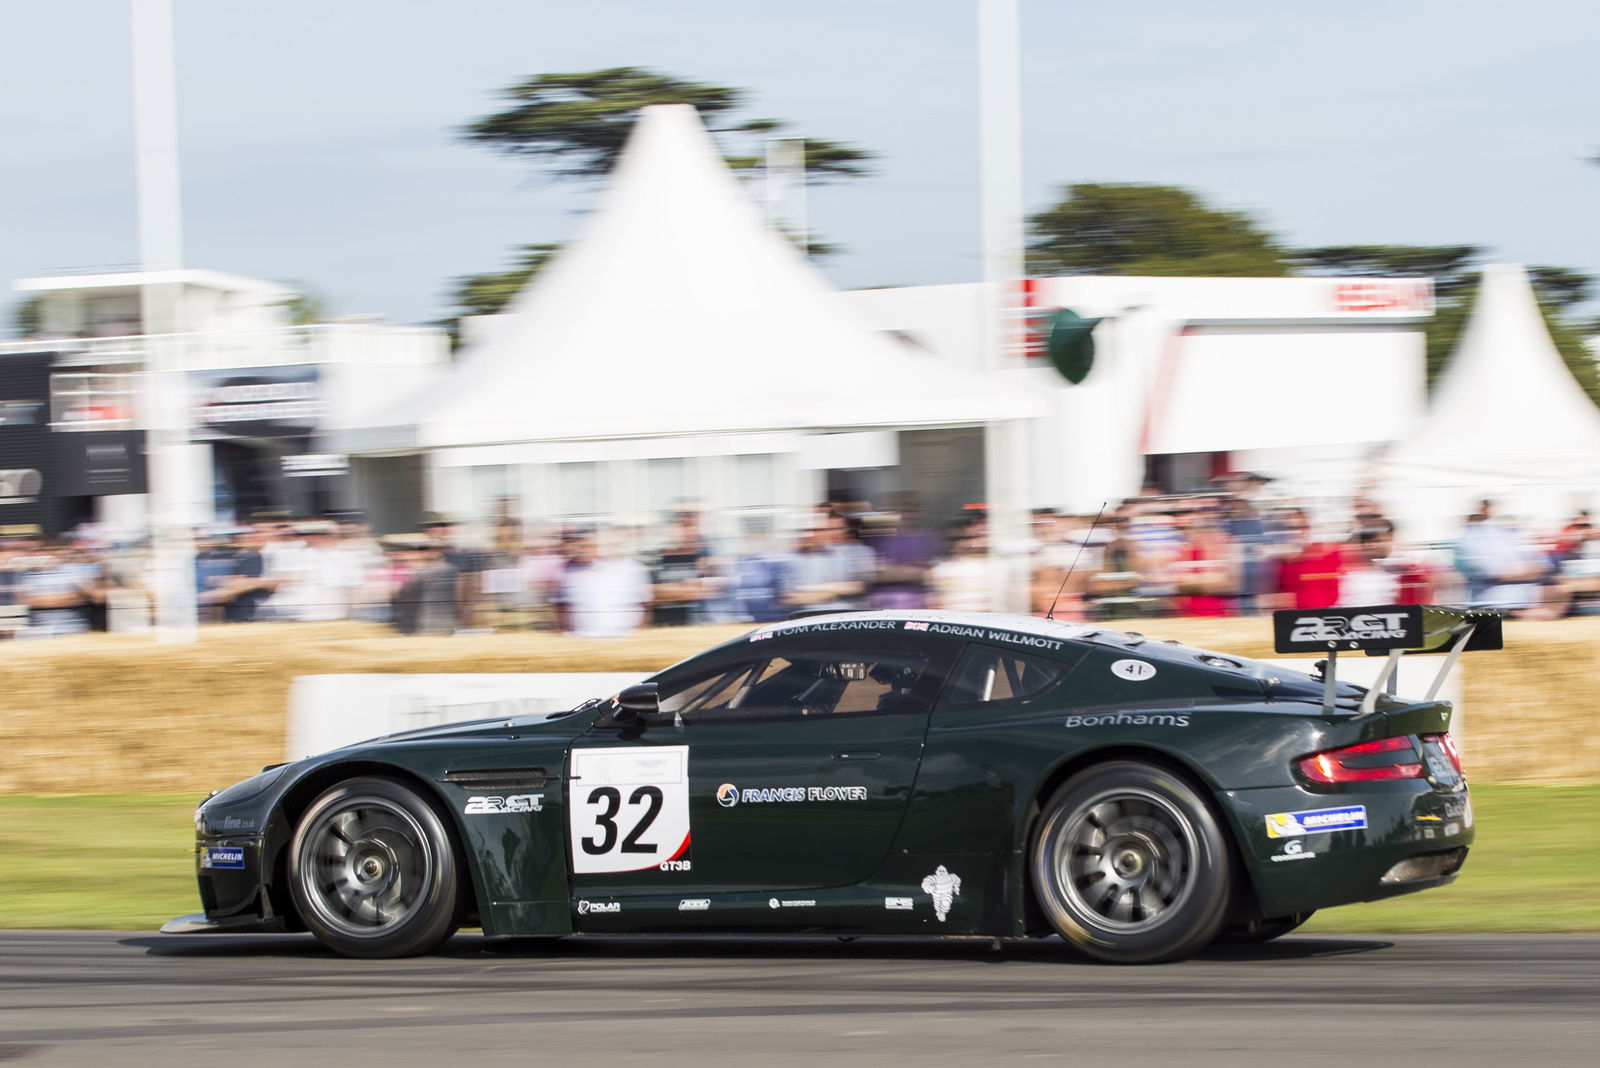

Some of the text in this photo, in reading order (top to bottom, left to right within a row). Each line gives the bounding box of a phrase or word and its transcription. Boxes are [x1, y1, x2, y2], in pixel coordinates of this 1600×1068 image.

[776, 620, 896, 637] TOM ALEXANDER
[928, 623, 1064, 651] ADRIAN WILLMOTT
[1125, 664, 1143, 675] 41
[1065, 713, 1191, 728] Bonhams
[741, 786, 868, 803] FRANCIS FLOWER
[581, 785, 664, 855] 32
[212, 852, 243, 861] MICHELIN
[660, 860, 691, 871] GT3B
[590, 902, 621, 910] POLAR
